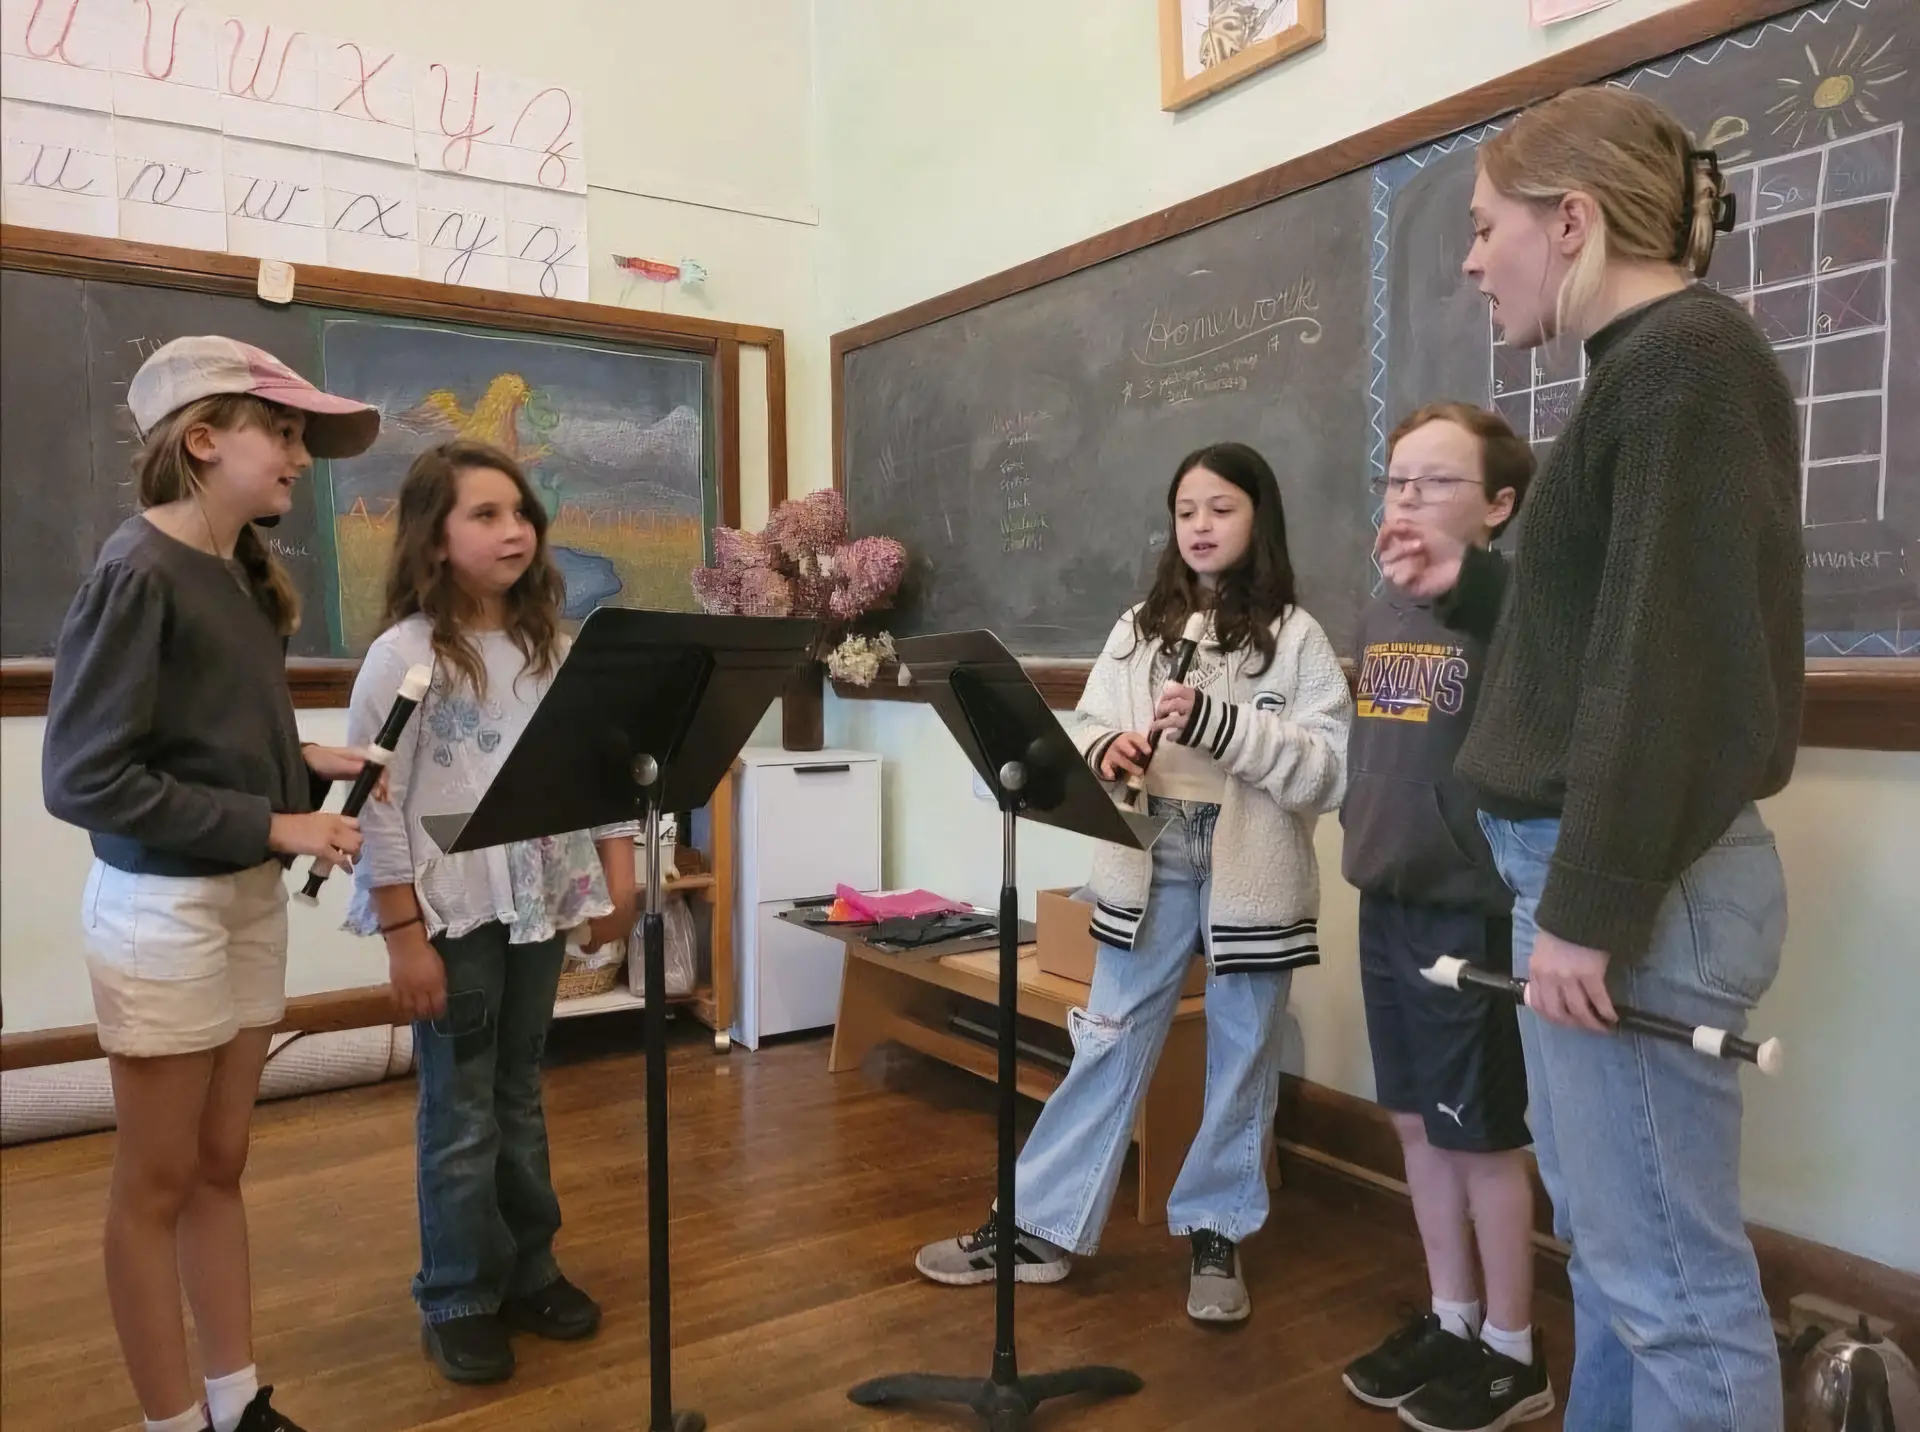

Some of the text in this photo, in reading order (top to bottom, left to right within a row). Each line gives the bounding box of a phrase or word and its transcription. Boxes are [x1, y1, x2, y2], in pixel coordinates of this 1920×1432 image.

[225, 19, 306, 101] W
[22, 144, 94, 190] u
[232, 178, 309, 221] w
[333, 194, 409, 239] x
[430, 213, 498, 285] y
[1357, 652, 1469, 716] AXONS
